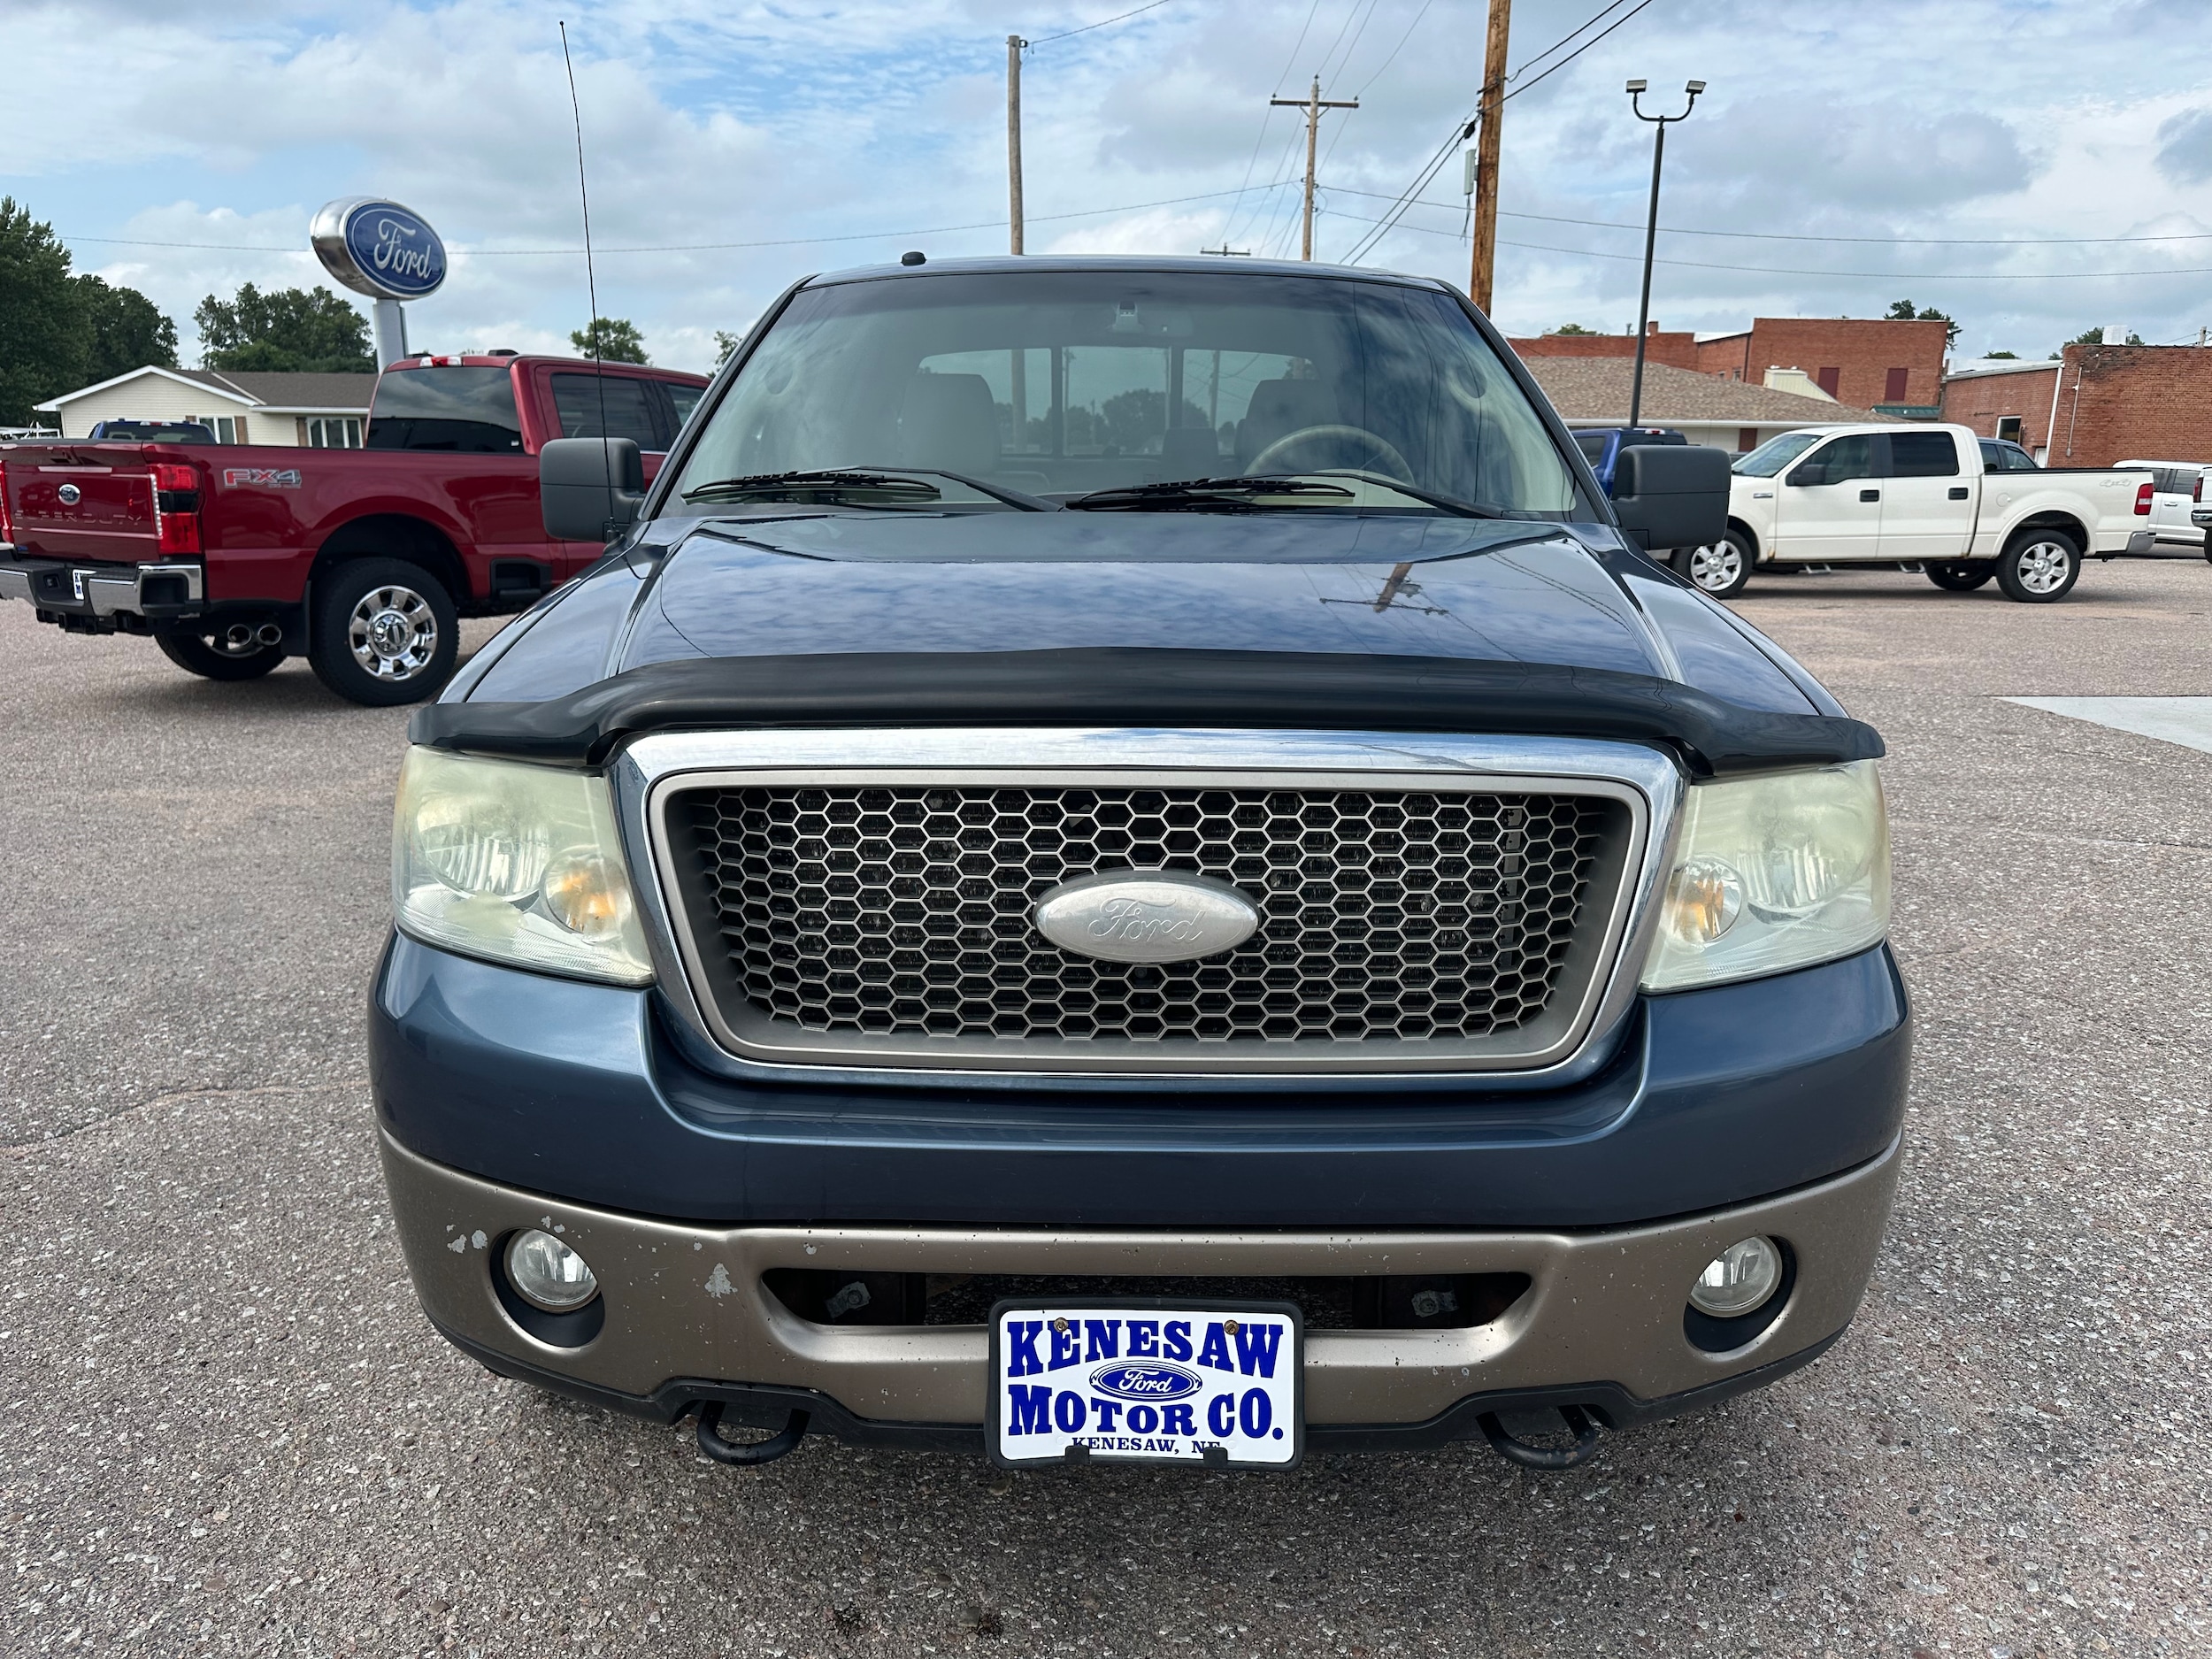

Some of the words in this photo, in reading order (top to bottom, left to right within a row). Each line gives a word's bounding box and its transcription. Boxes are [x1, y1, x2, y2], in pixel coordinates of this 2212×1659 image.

[373, 219, 433, 280] Ford
[223, 468, 302, 488] FX4
[1087, 897, 1206, 942] Ford
[1007, 1318, 1284, 1379] KENESAW
[1118, 1369, 1173, 1393] Ford
[1007, 1384, 1198, 1437] MOTOR
[1207, 1387, 1284, 1440] CO.
[1071, 1437, 1179, 1455] KENESAW,
